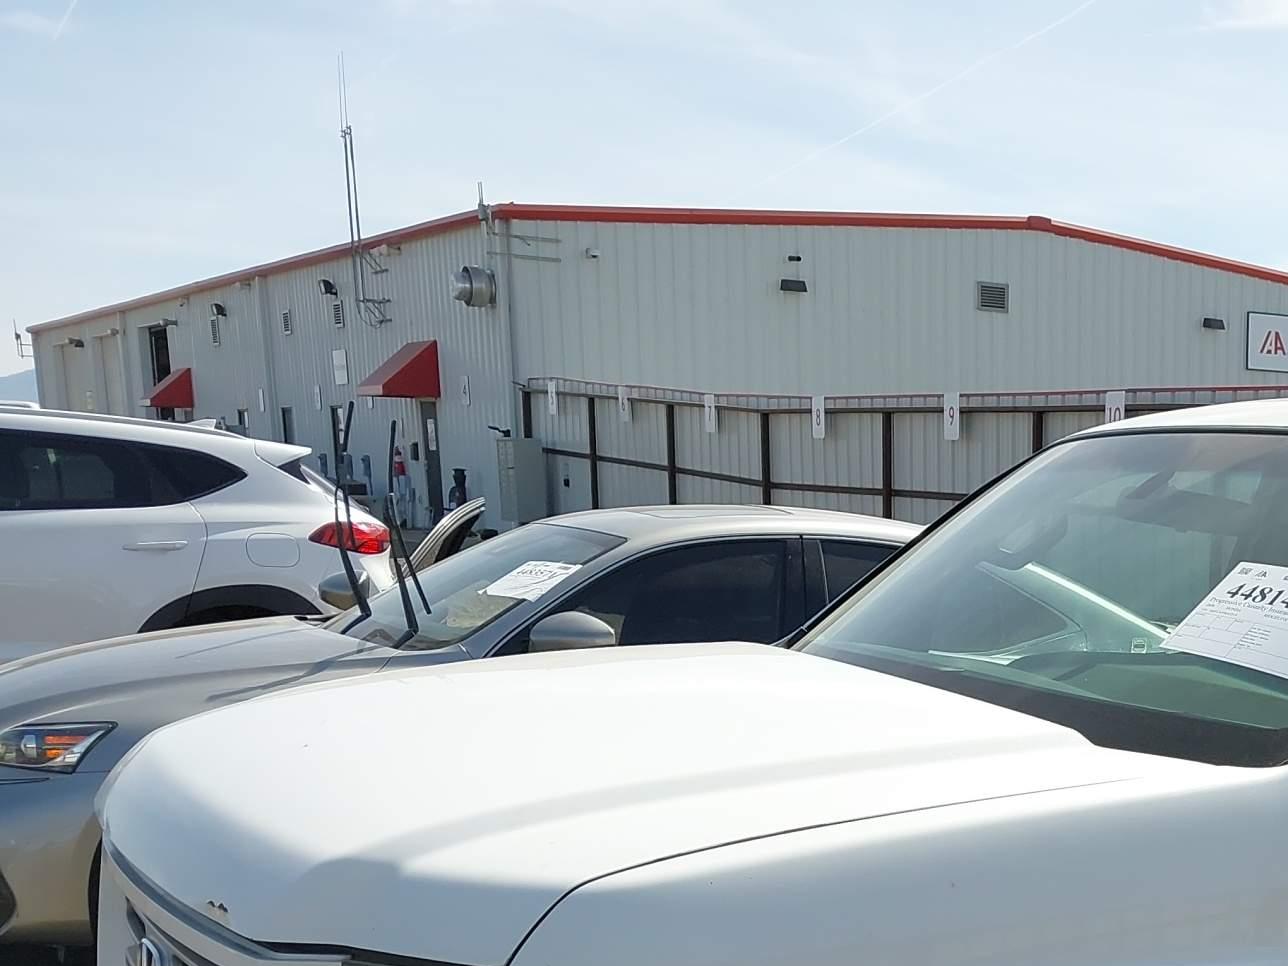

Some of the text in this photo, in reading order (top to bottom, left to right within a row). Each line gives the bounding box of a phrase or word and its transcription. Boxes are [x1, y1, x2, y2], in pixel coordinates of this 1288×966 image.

[815, 408, 821, 426] 8
[948, 406, 955, 425] 9
[1108, 408, 1121, 423] 10
